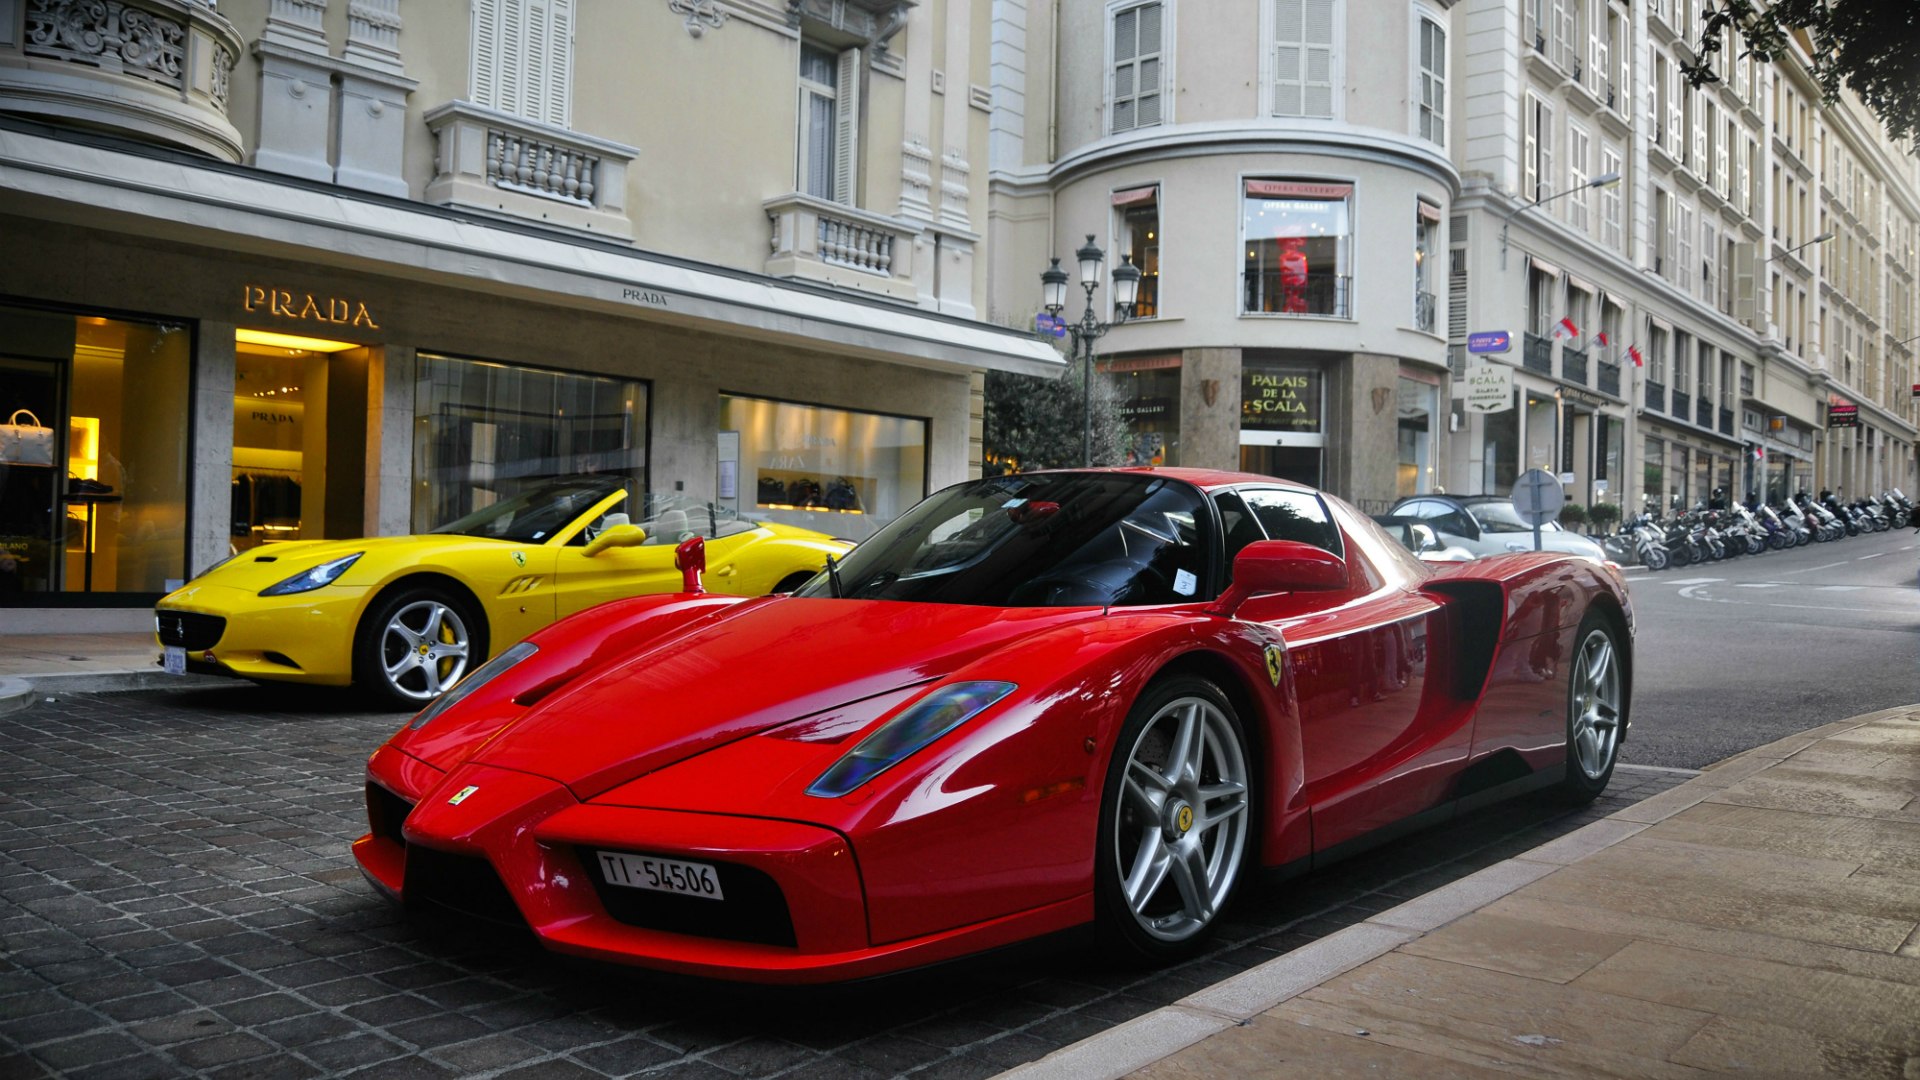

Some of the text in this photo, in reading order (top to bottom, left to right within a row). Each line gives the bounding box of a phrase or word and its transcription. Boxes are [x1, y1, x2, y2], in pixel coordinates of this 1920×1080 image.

[1264, 184, 1293, 192] OPERA
[623, 288, 667, 306] PRADA
[244, 285, 380, 329] PRADA
[1481, 367, 1493, 375] LA
[1251, 374, 1308, 388] PALAIS
[1469, 376, 1506, 385] SCALA
[1262, 388, 1297, 399] DE LA
[1252, 399, 1307, 413] SCALA
[251, 411, 295, 424] PRADA
